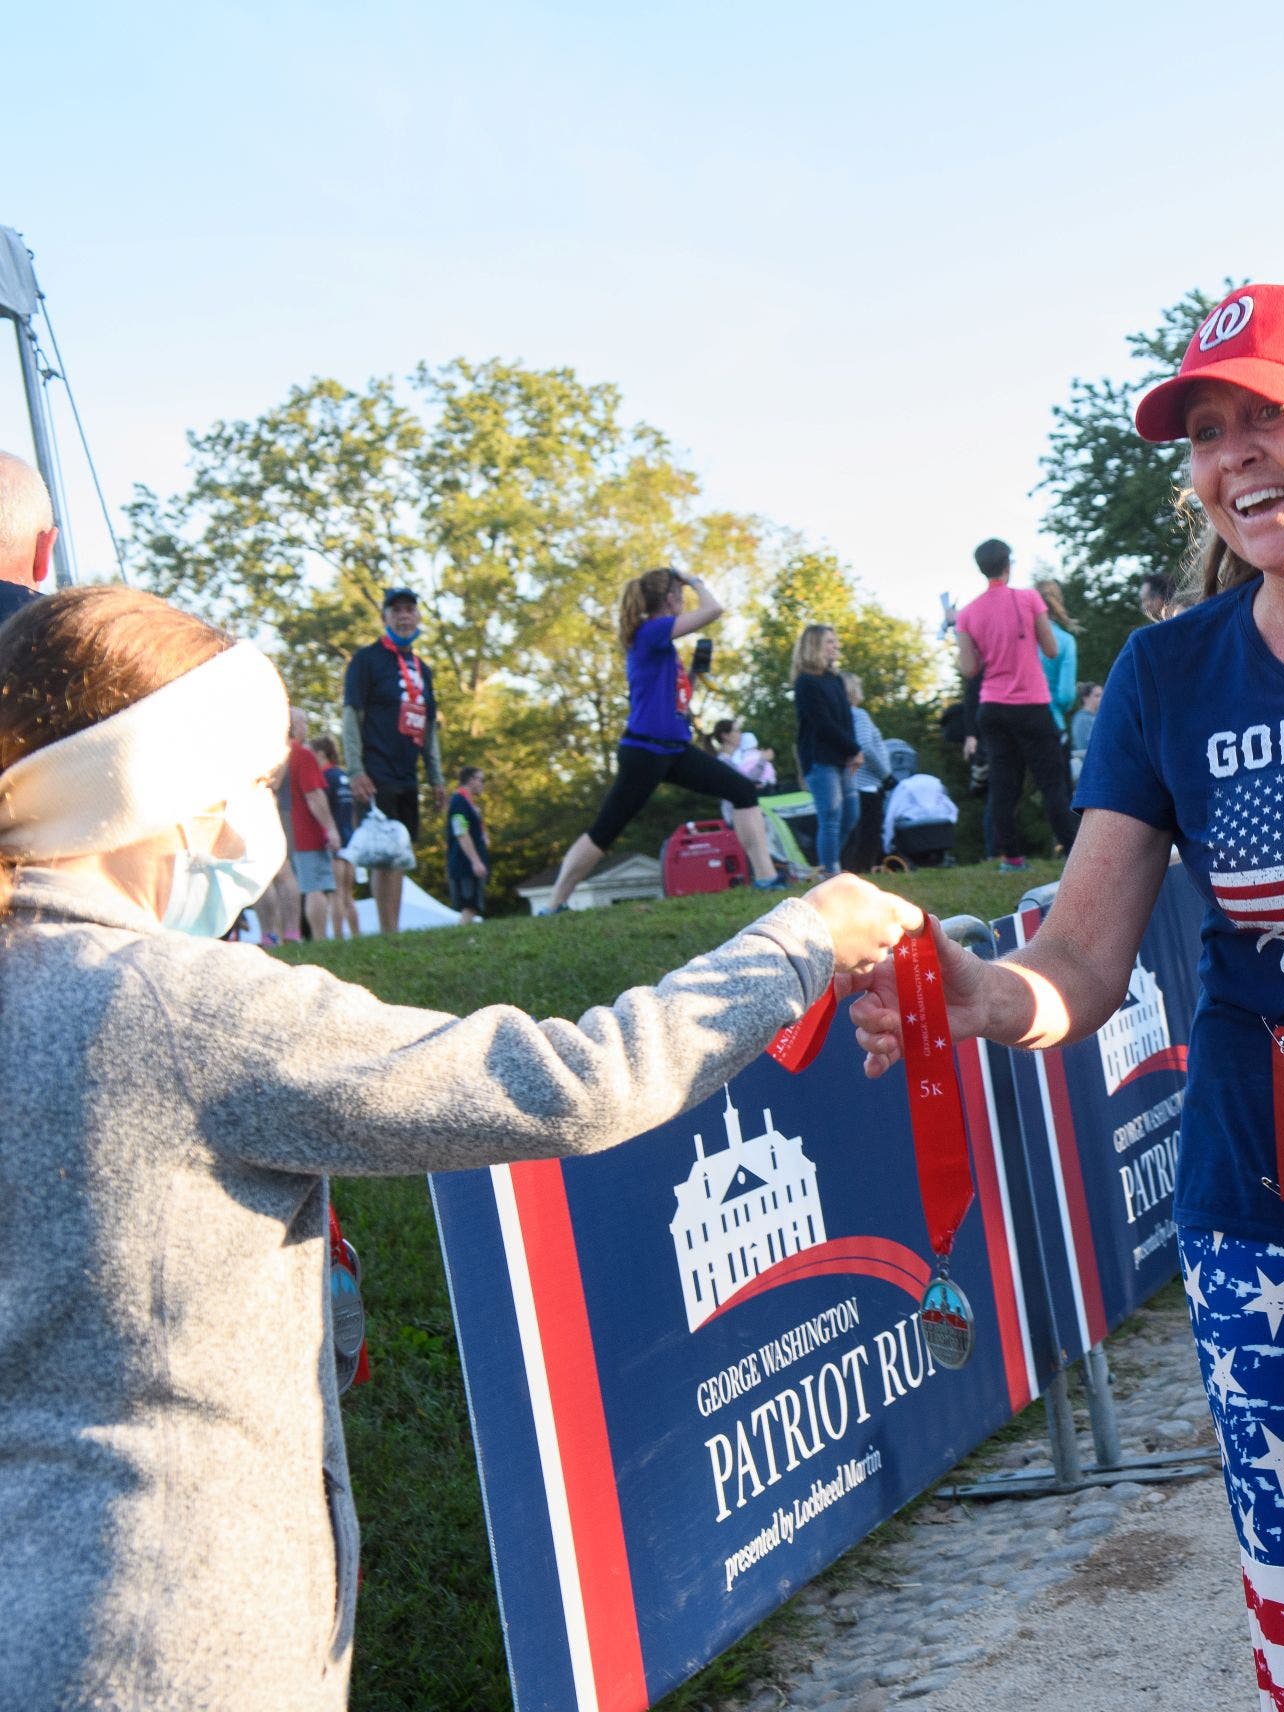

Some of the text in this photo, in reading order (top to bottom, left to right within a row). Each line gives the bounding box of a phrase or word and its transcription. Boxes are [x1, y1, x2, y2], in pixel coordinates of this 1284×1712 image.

[920, 1079, 943, 1098] 5K
[1119, 1130, 1181, 1224] PATRI
[697, 1353, 762, 1417] GEORGE
[759, 1297, 861, 1377] WASHINGTON
[704, 1345, 871, 1523] PATRIOT
[725, 1444, 882, 1592] presented by Lockheed Martin
